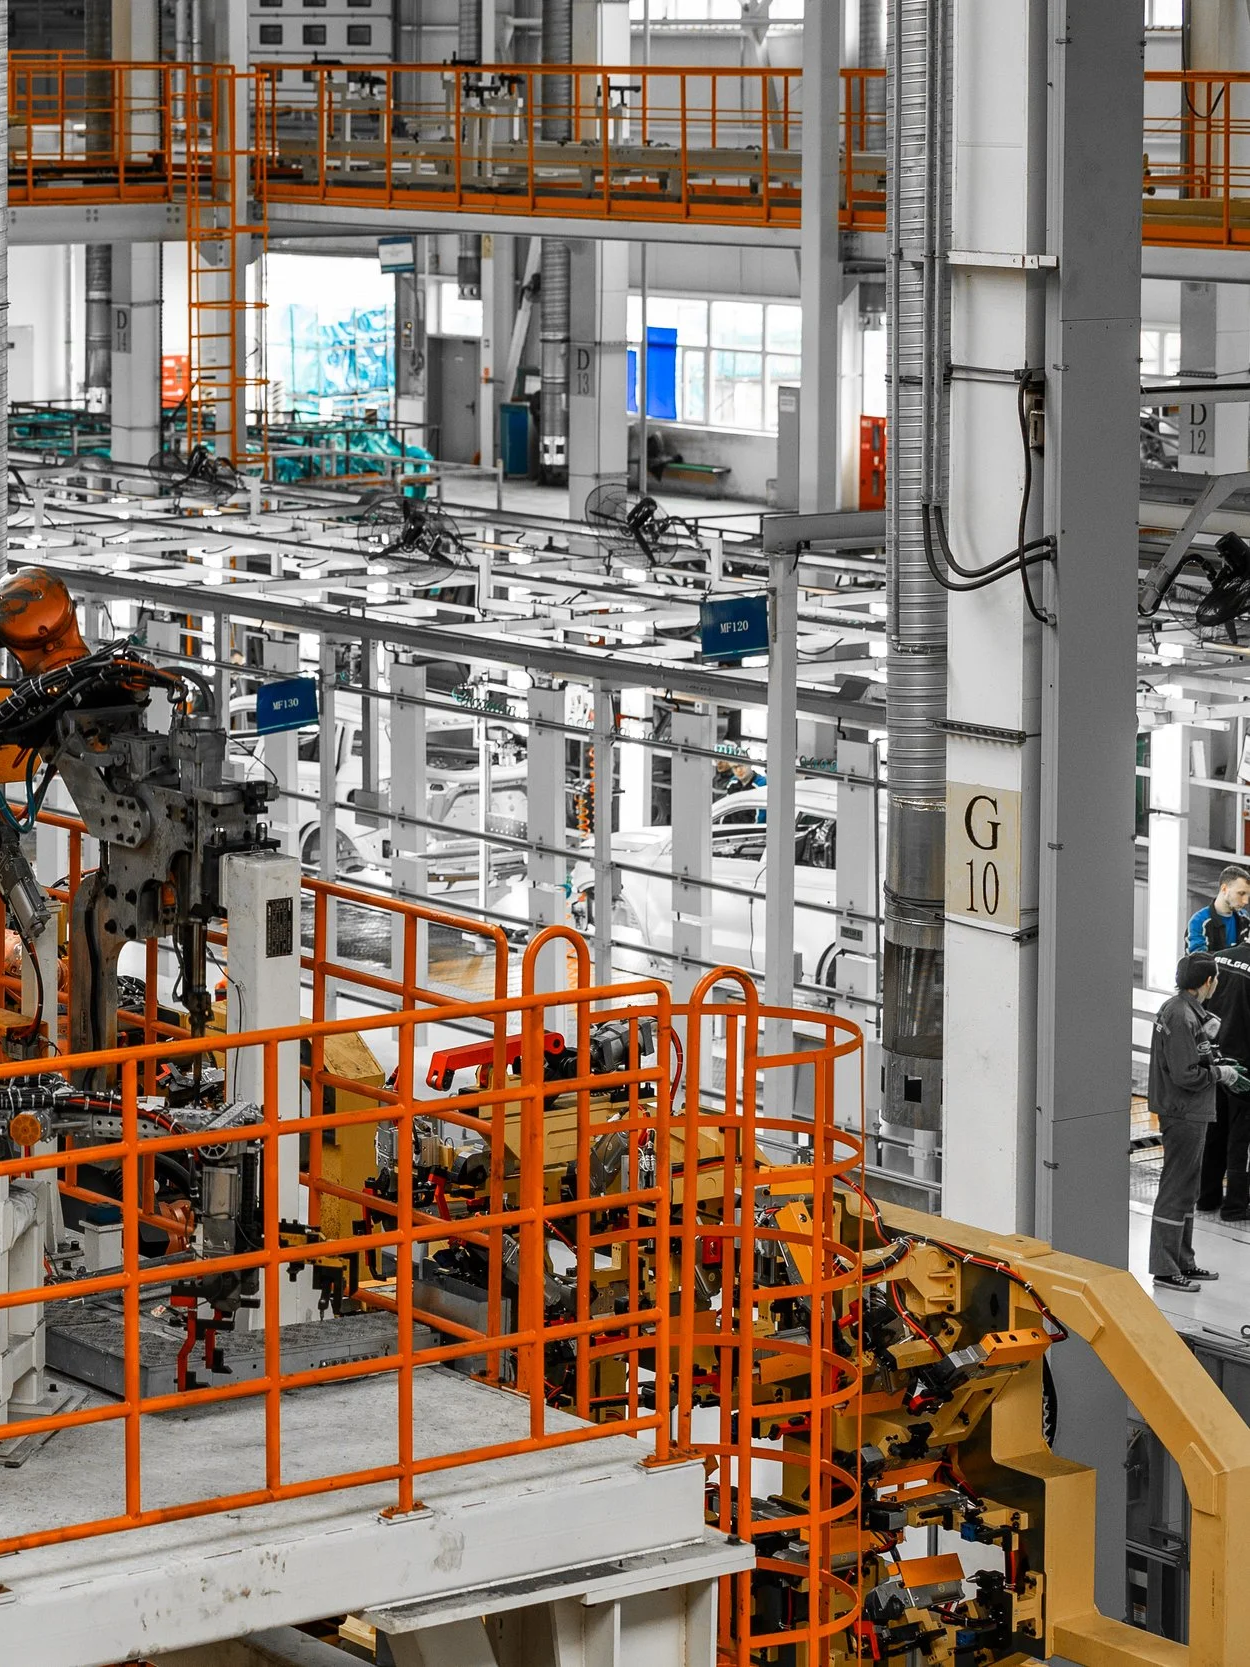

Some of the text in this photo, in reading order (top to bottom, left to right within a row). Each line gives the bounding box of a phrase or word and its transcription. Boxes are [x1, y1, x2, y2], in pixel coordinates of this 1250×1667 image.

[117, 310, 127, 329] D
[577, 348, 590, 370] D
[577, 373, 590, 395] 13
[1190, 404, 1207, 425] D
[1190, 429, 1207, 454] 12
[720, 620, 749, 634] MF120
[964, 795, 1001, 850] G
[966, 859, 999, 915] 10
